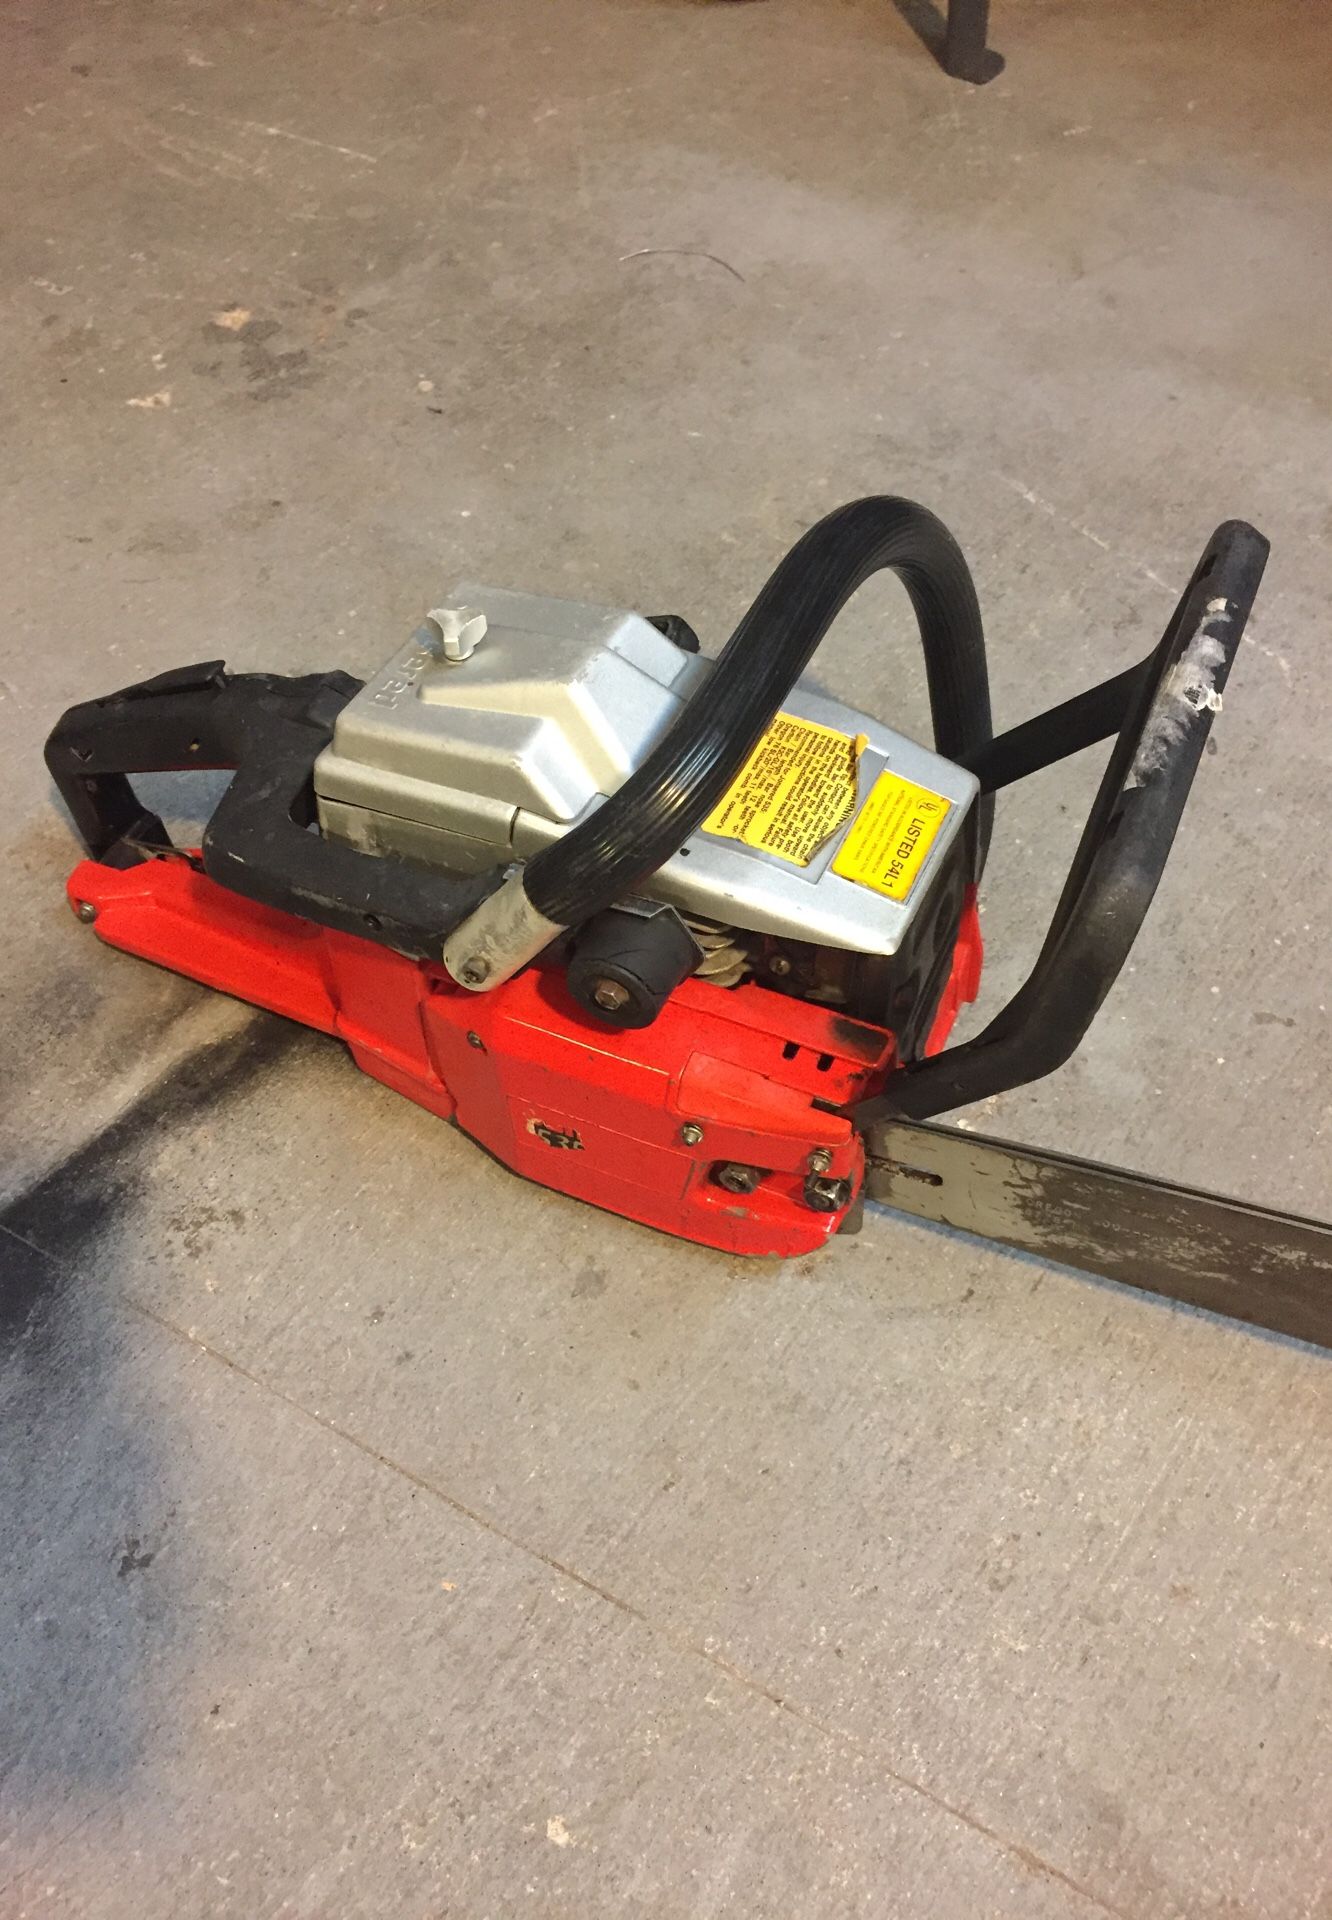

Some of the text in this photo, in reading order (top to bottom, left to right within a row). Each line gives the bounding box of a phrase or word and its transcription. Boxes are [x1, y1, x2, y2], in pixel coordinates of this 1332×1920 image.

[749, 794, 758, 802] 12
[894, 817, 925, 860] LISTED
[880, 858, 904, 888] 54L1
